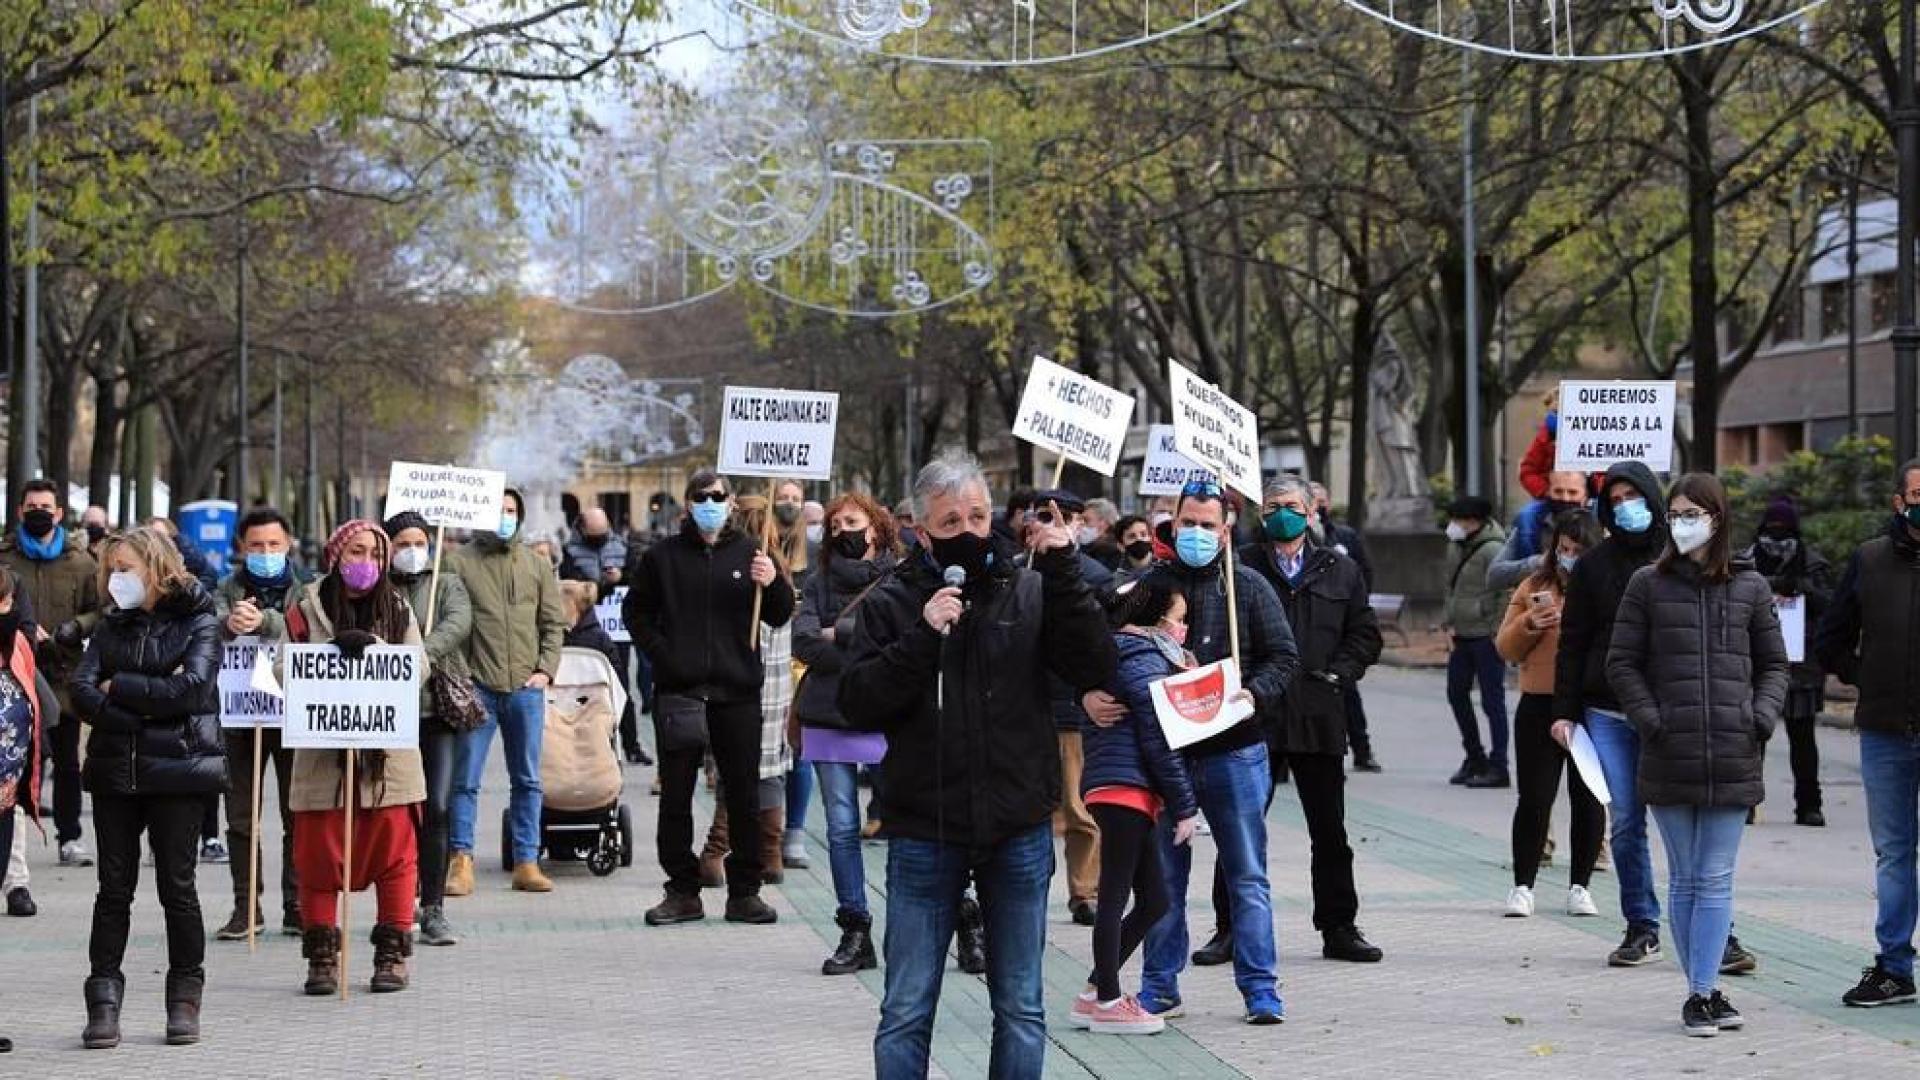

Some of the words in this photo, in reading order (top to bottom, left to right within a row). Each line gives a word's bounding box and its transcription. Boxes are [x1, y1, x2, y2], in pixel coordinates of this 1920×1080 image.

[1057, 377, 1113, 419] HECHOS
[1578, 388, 1657, 404] QUEREMOS
[729, 397, 761, 422] KALTE
[815, 400, 832, 425] BAI
[1178, 399, 1226, 440] "AYUDA
[1228, 433, 1235, 450] A
[1237, 439, 1251, 459] LA
[1565, 416, 1627, 431] "AYUDAS
[1631, 416, 1641, 431] A
[1645, 416, 1662, 431] LA
[1030, 411, 1112, 463] PALABRERIA
[1160, 435, 1178, 453] NO
[744, 441, 796, 466] LIMOSNAK
[796, 443, 810, 466] EZ
[1577, 443, 1651, 458] ALEMANA"
[409, 470, 485, 488] QUEREMOS
[1146, 466, 1185, 485] DEJADO
[459, 492, 468, 503] A
[473, 494, 490, 505] LA
[292, 651, 413, 681] NECESITAMOS
[305, 704, 397, 732] TRABAJAR
